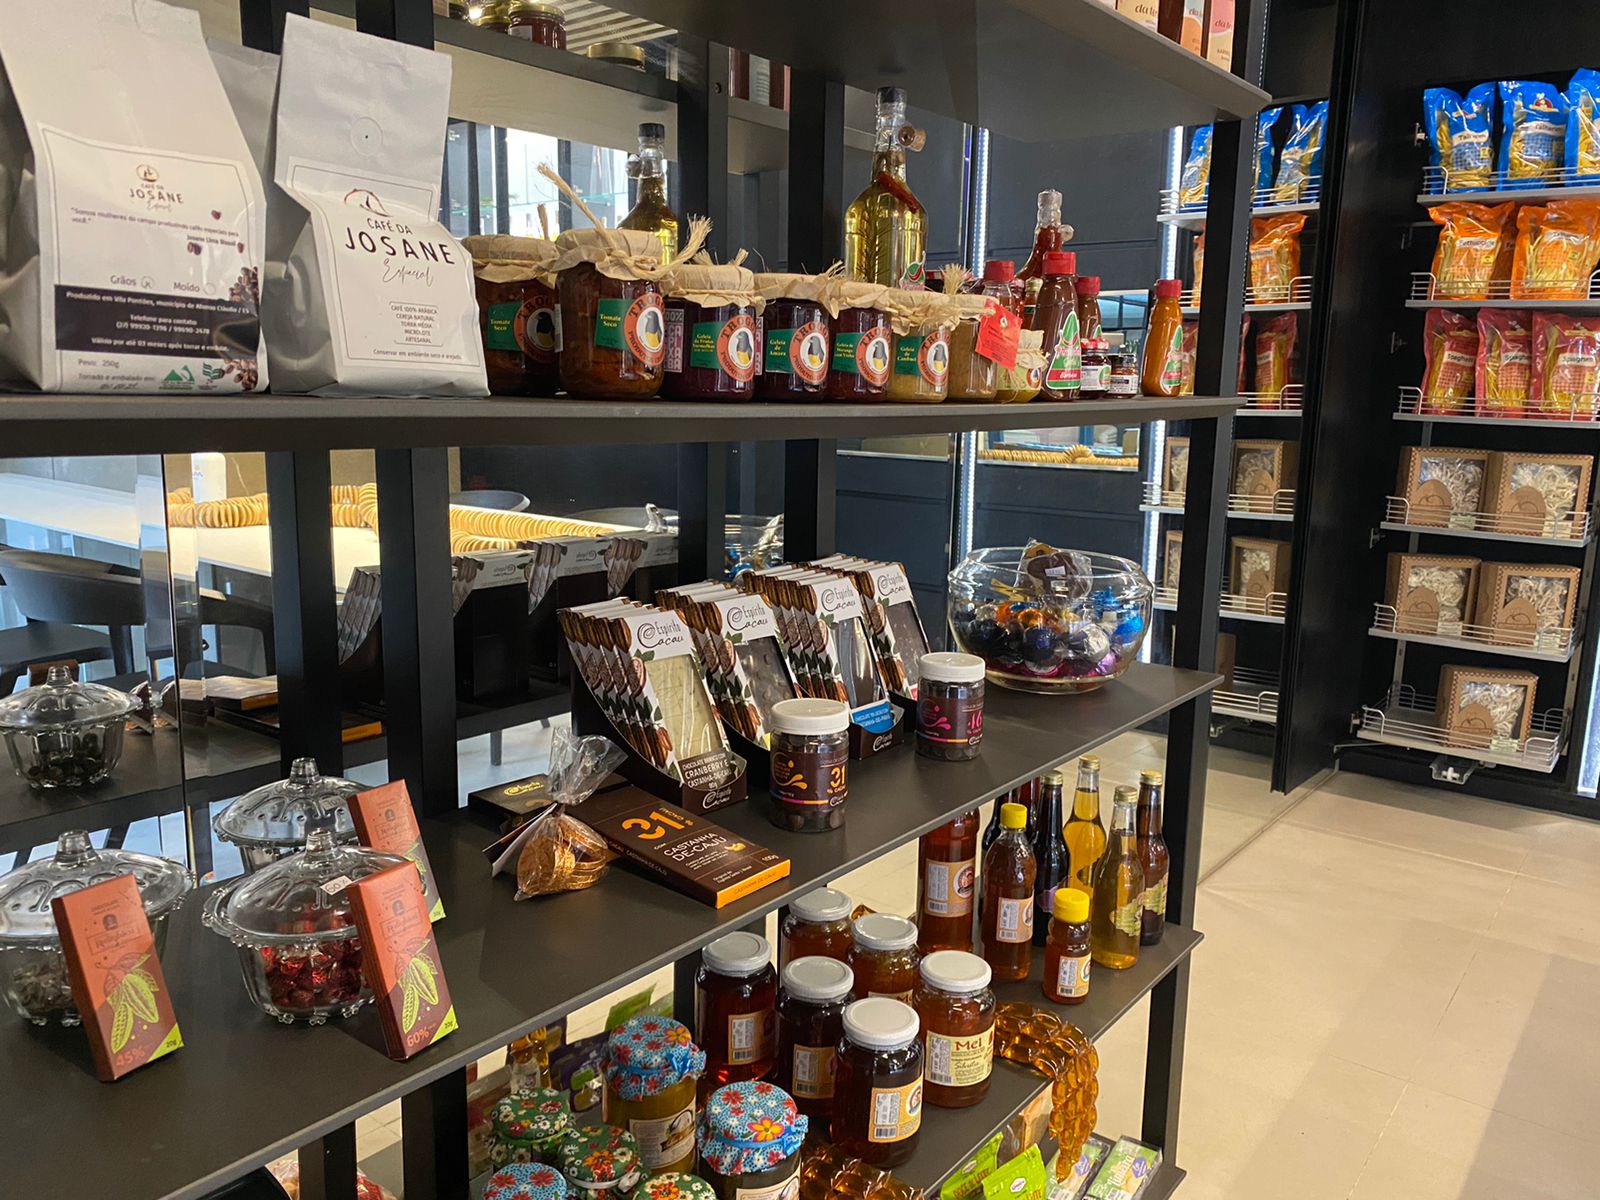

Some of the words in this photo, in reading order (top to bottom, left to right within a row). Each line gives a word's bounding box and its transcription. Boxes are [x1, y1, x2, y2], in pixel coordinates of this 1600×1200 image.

[129, 188, 184, 204] JOSANE
[367, 217, 395, 232] CAFÉ
[396, 224, 413, 235] DA
[345, 227, 455, 265] JOSANE
[110, 274, 137, 287] Grãos
[600, 314, 621, 322] Tomate
[637, 623, 684, 648] Cacau
[685, 761, 723, 780] CRANBERRY
[724, 759, 729, 767] E
[830, 765, 846, 788] 31
[622, 811, 685, 840] 31
[671, 836, 728, 862] DE-CAJU
[406, 1026, 430, 1048] 60%
[954, 1037, 982, 1051] Mel
[115, 1047, 147, 1068] 45%
